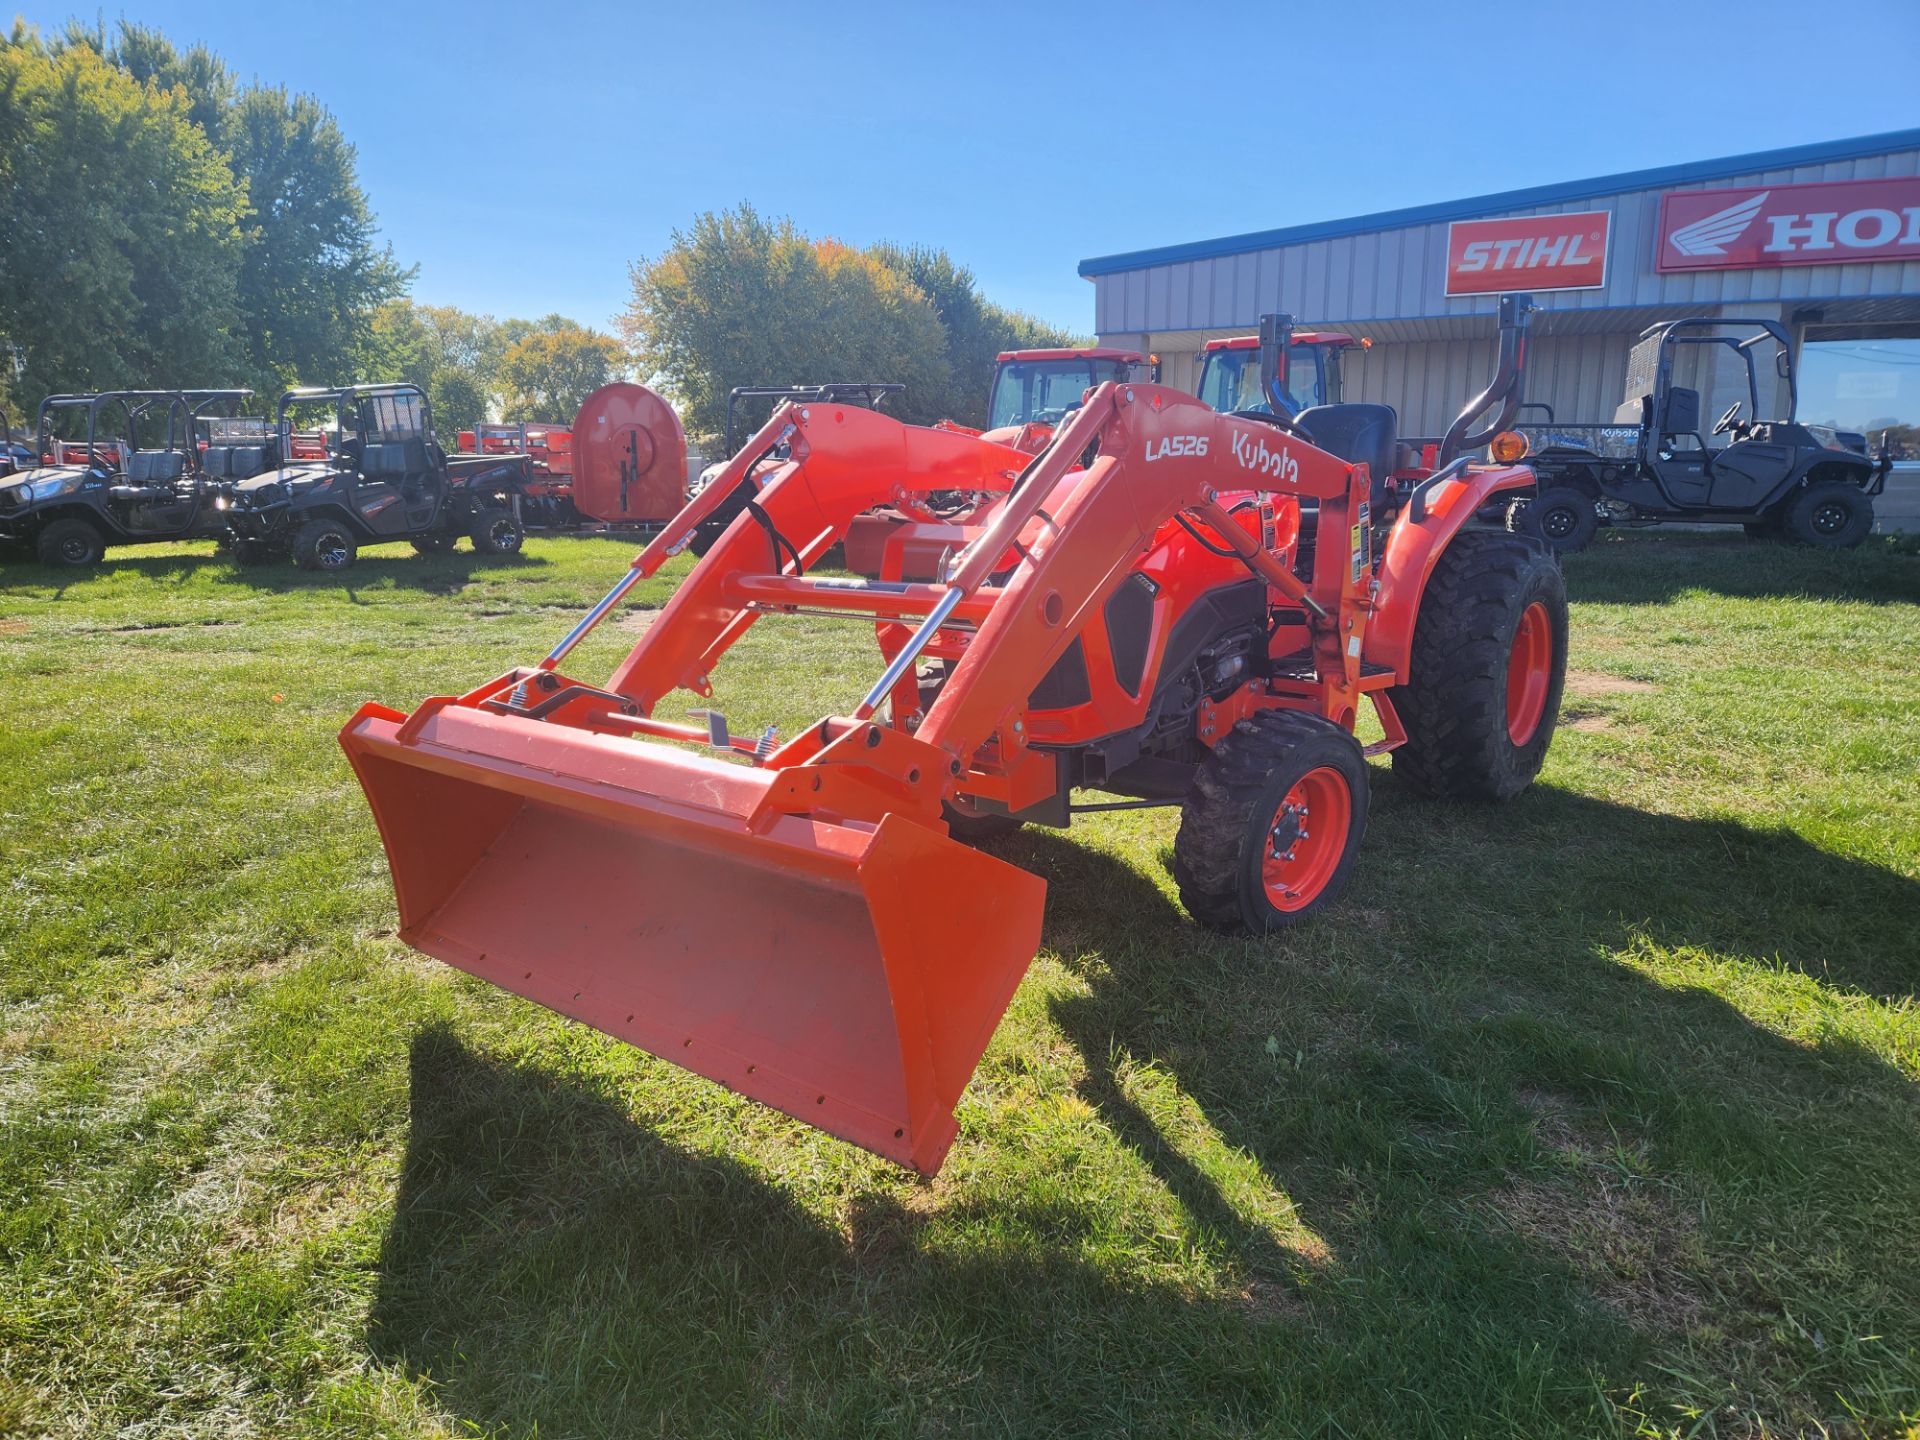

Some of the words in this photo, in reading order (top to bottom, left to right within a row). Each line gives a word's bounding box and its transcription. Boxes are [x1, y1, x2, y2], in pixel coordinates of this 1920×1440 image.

[1456, 234, 1593, 273] STIHL
[1145, 435, 1209, 462] LA526
[1601, 428, 1640, 438] Kubota
[1232, 429, 1299, 483] Kubota
